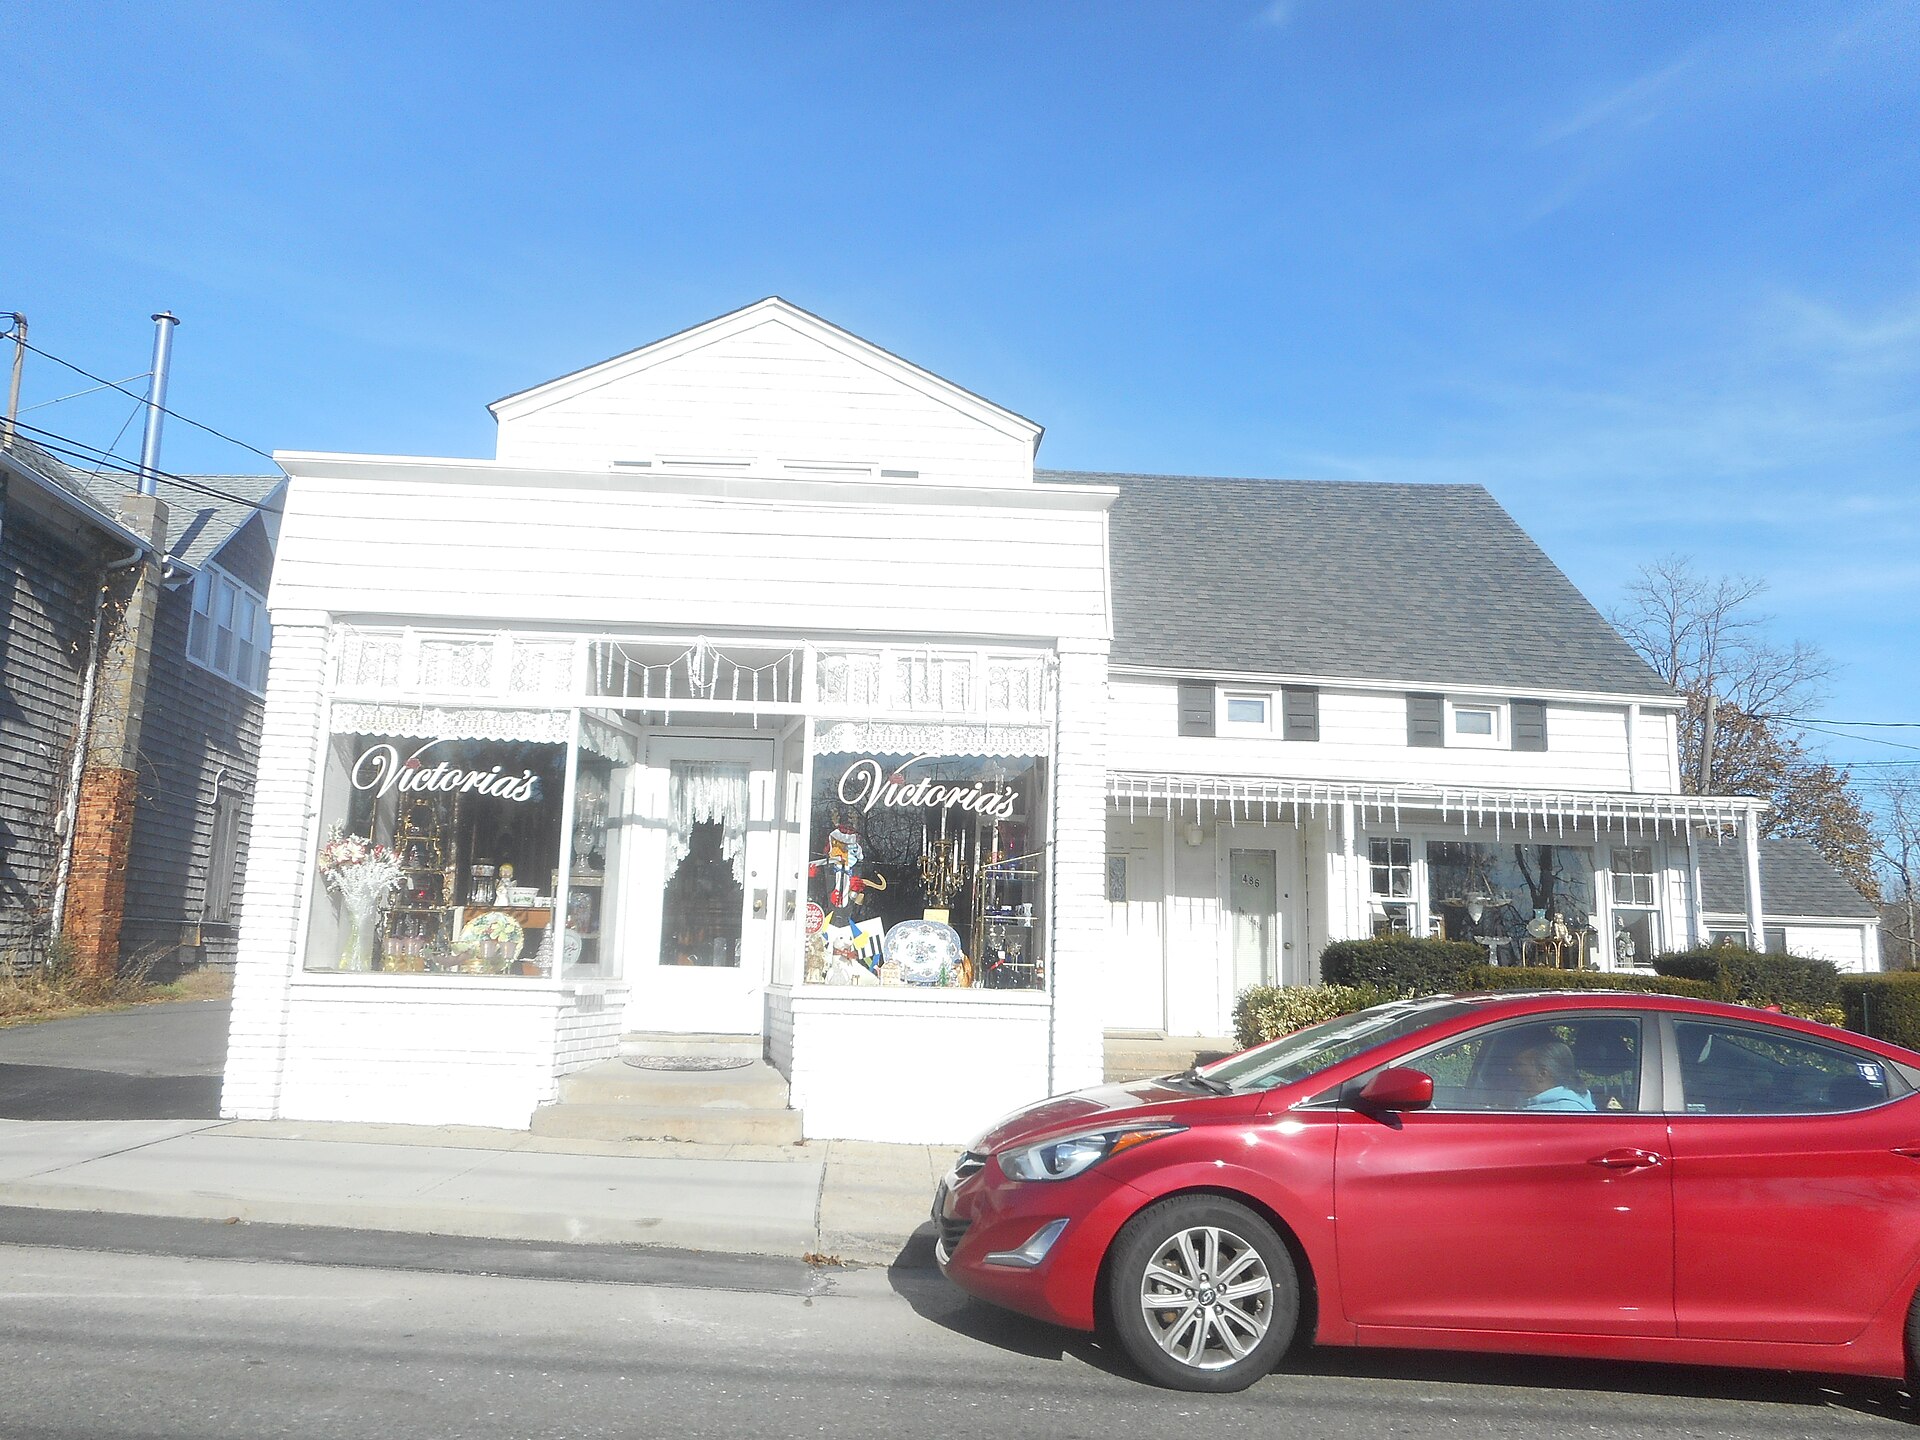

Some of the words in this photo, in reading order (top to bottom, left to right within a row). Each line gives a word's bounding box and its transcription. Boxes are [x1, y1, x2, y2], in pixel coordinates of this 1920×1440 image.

[351, 739, 538, 801] Victoria's
[838, 753, 1019, 817] Victoria's
[1242, 874, 1260, 888] 486
